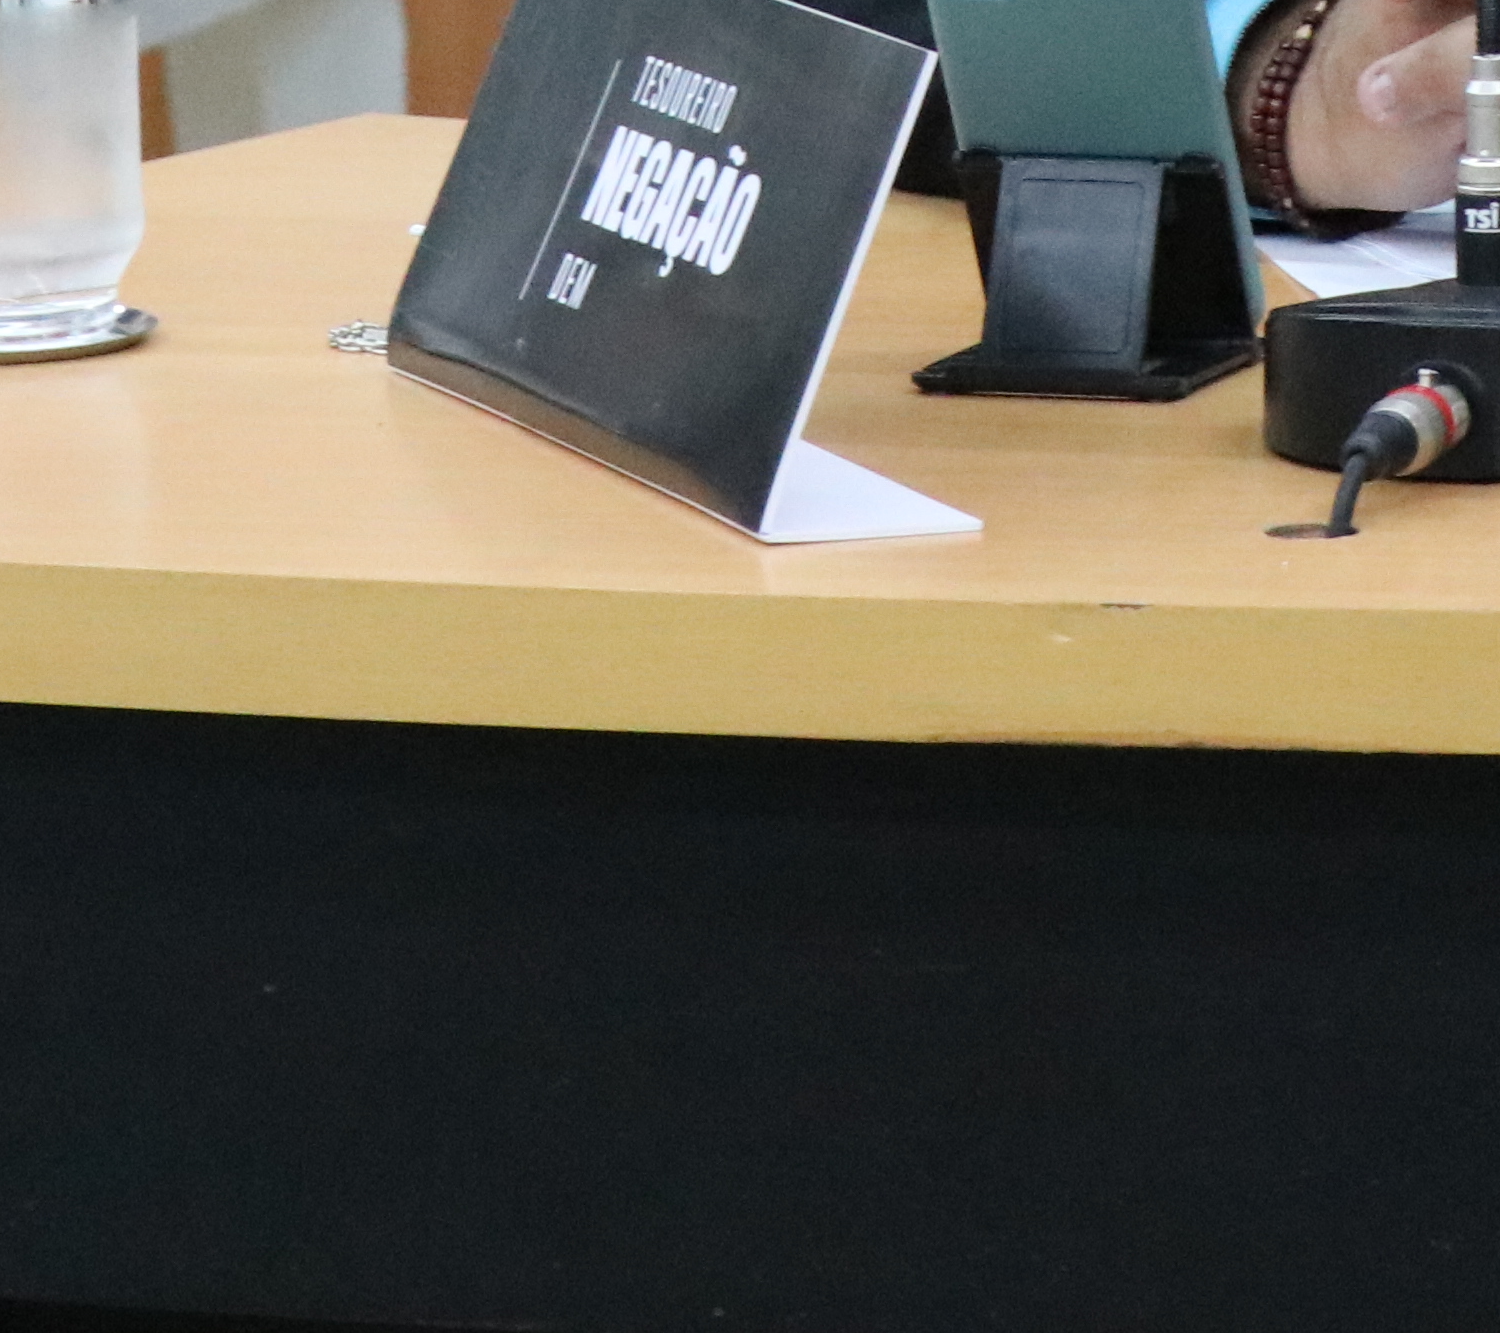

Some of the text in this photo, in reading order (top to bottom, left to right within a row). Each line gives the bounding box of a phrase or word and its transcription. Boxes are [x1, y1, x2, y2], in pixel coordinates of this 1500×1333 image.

[630, 54, 739, 134] TESOUREIRO
[580, 124, 763, 278] NEGAÇÃO
[546, 252, 599, 311] DEM
